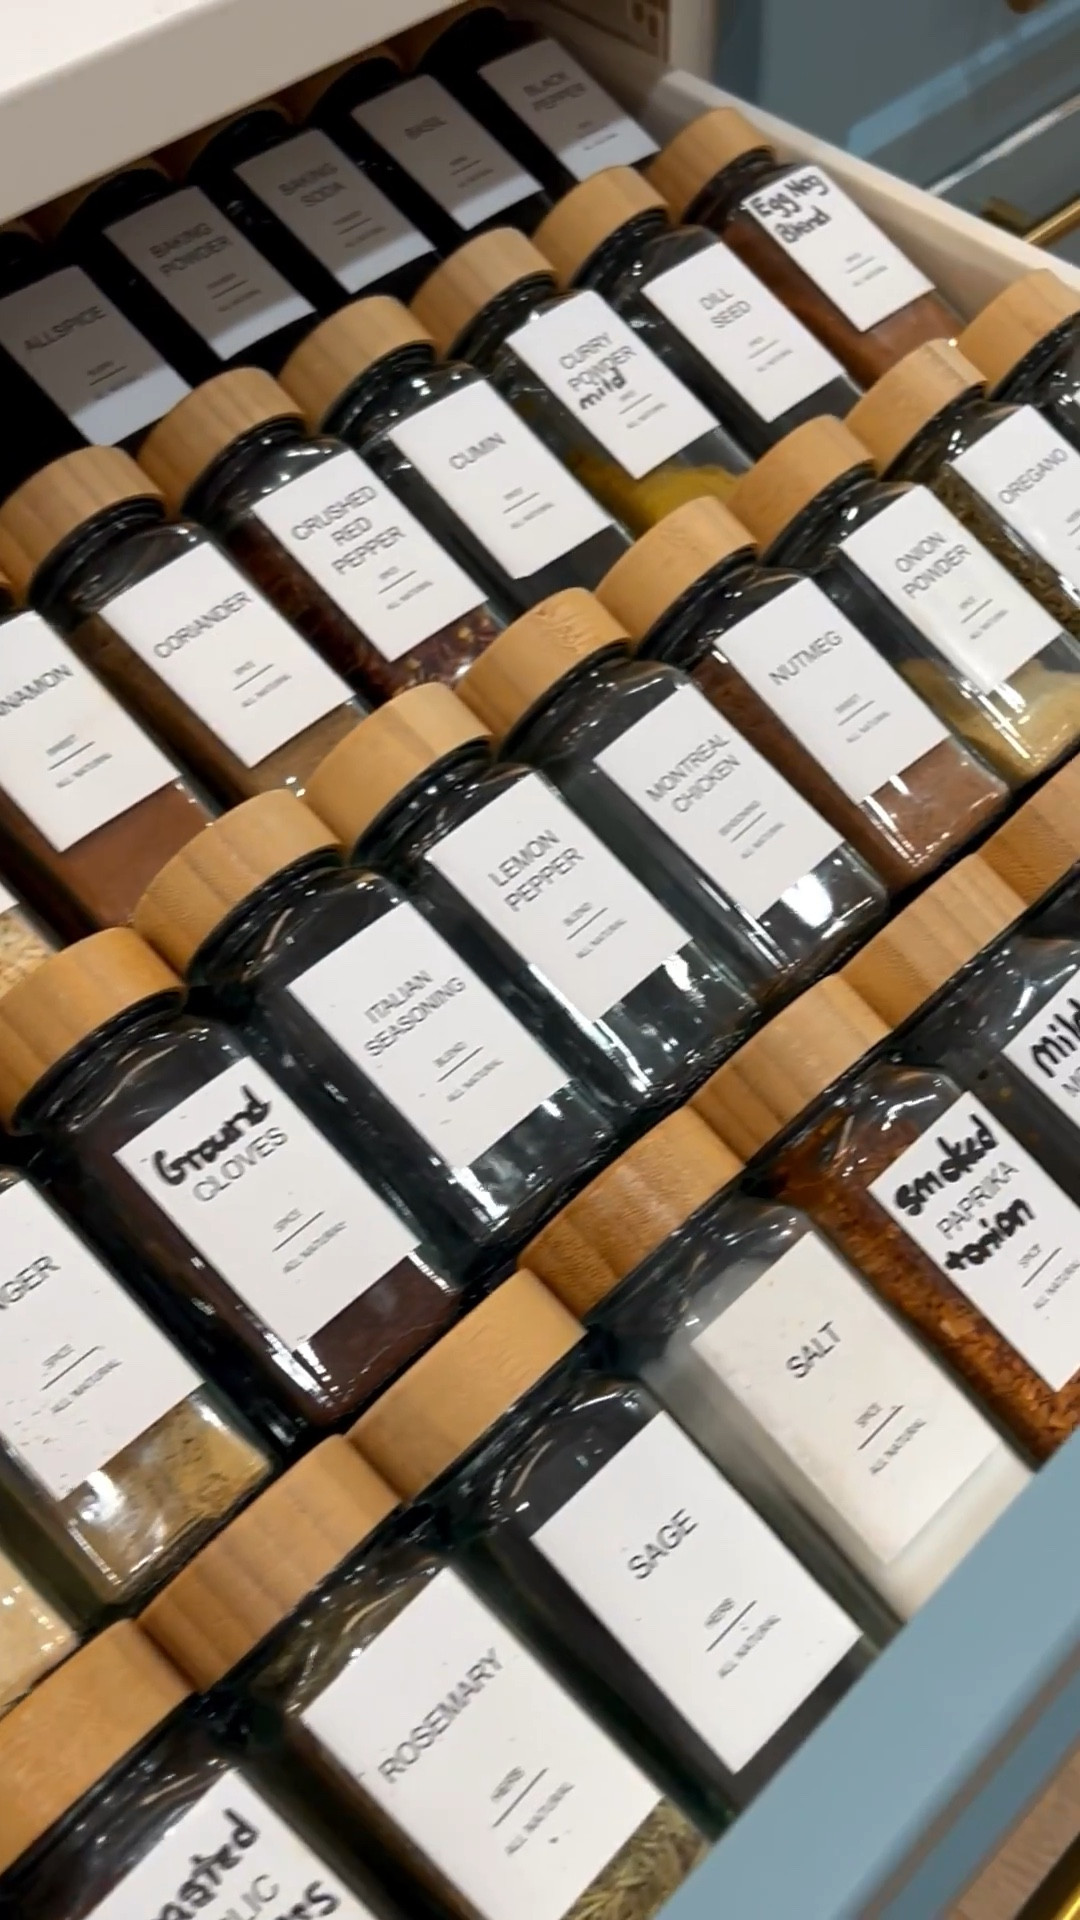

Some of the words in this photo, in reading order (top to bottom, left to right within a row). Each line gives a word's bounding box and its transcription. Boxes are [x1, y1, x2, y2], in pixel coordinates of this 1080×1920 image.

[749, 193, 802, 219] Egg
[149, 222, 213, 258] BAKING
[159, 235, 233, 276] POWDER
[699, 288, 735, 310] DILL
[710, 300, 751, 329] SEED
[24, 305, 106, 350] ALLSPICE
[559, 332, 612, 369] CURRY
[567, 345, 637, 391] POWDER
[579, 367, 628, 409] mild
[449, 432, 507, 470] CUMIN
[998, 448, 1069, 504] OREGANO
[290, 485, 377, 540] CRUSHED
[330, 516, 373, 547] RED
[331, 525, 407, 575] PEPPER
[895, 531, 947, 573] ONION
[902, 544, 971, 599] POWDER
[153, 591, 254, 658] CORIANDER
[768, 630, 843, 686] NUTMEG
[646, 735, 730, 802] MONTREAL
[671, 755, 741, 813] CHICKEN
[488, 829, 560, 887] LEMON
[504, 847, 584, 912] PEPPER
[364, 970, 434, 1024] ITALIAN
[364, 976, 467, 1057] SEASONING
[153, 1084, 271, 1186] Ground
[192, 1127, 288, 1201] CLOVES
[895, 1112, 998, 1216] smoked
[936, 1161, 1019, 1239] PAPRIKA
[786, 1320, 841, 1379] SALT
[627, 1507, 698, 1580] SAGE
[378, 1647, 503, 1784] ROSEMARY
